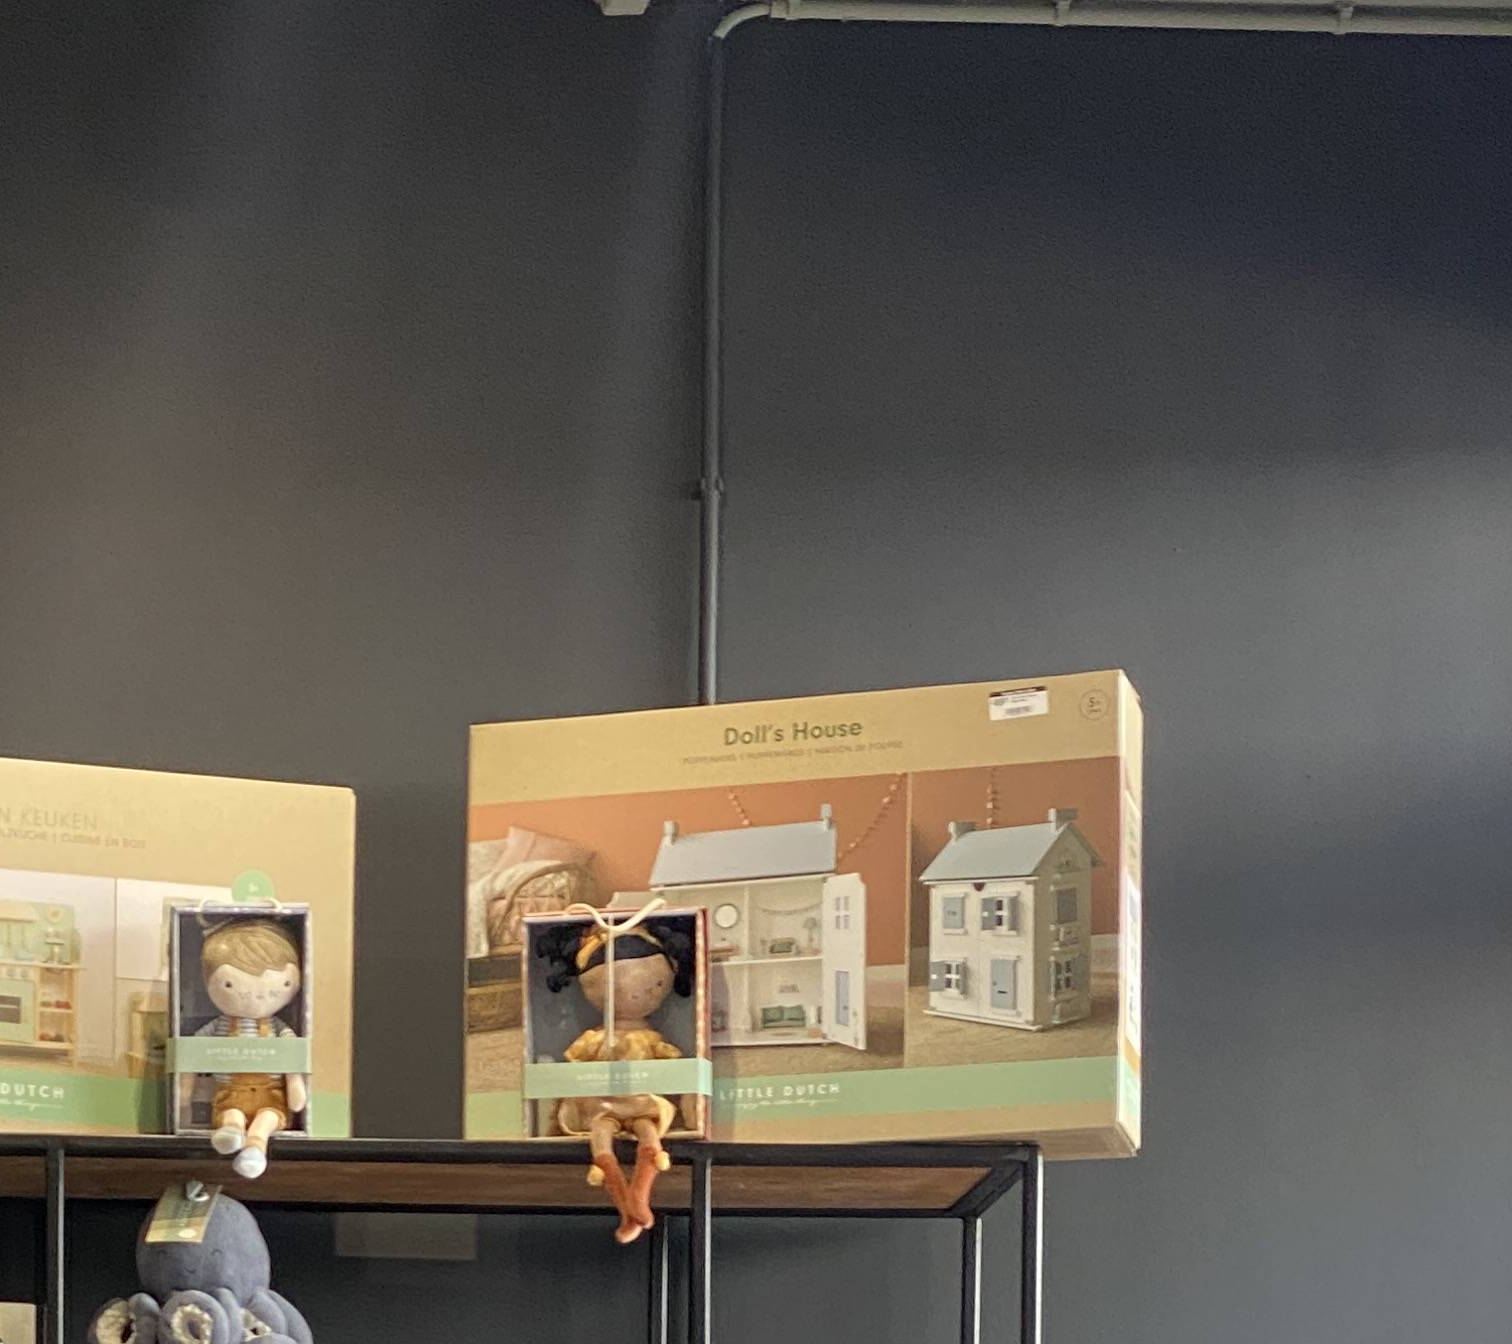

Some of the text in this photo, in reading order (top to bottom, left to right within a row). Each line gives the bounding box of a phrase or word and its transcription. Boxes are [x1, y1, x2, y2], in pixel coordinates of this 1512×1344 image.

[723, 720, 864, 746] Doll's House
[20, 808, 98, 831] KEUKEN
[0, 1079, 66, 1100] DUTCH
[719, 1082, 841, 1101] LITTLE DUTCH
